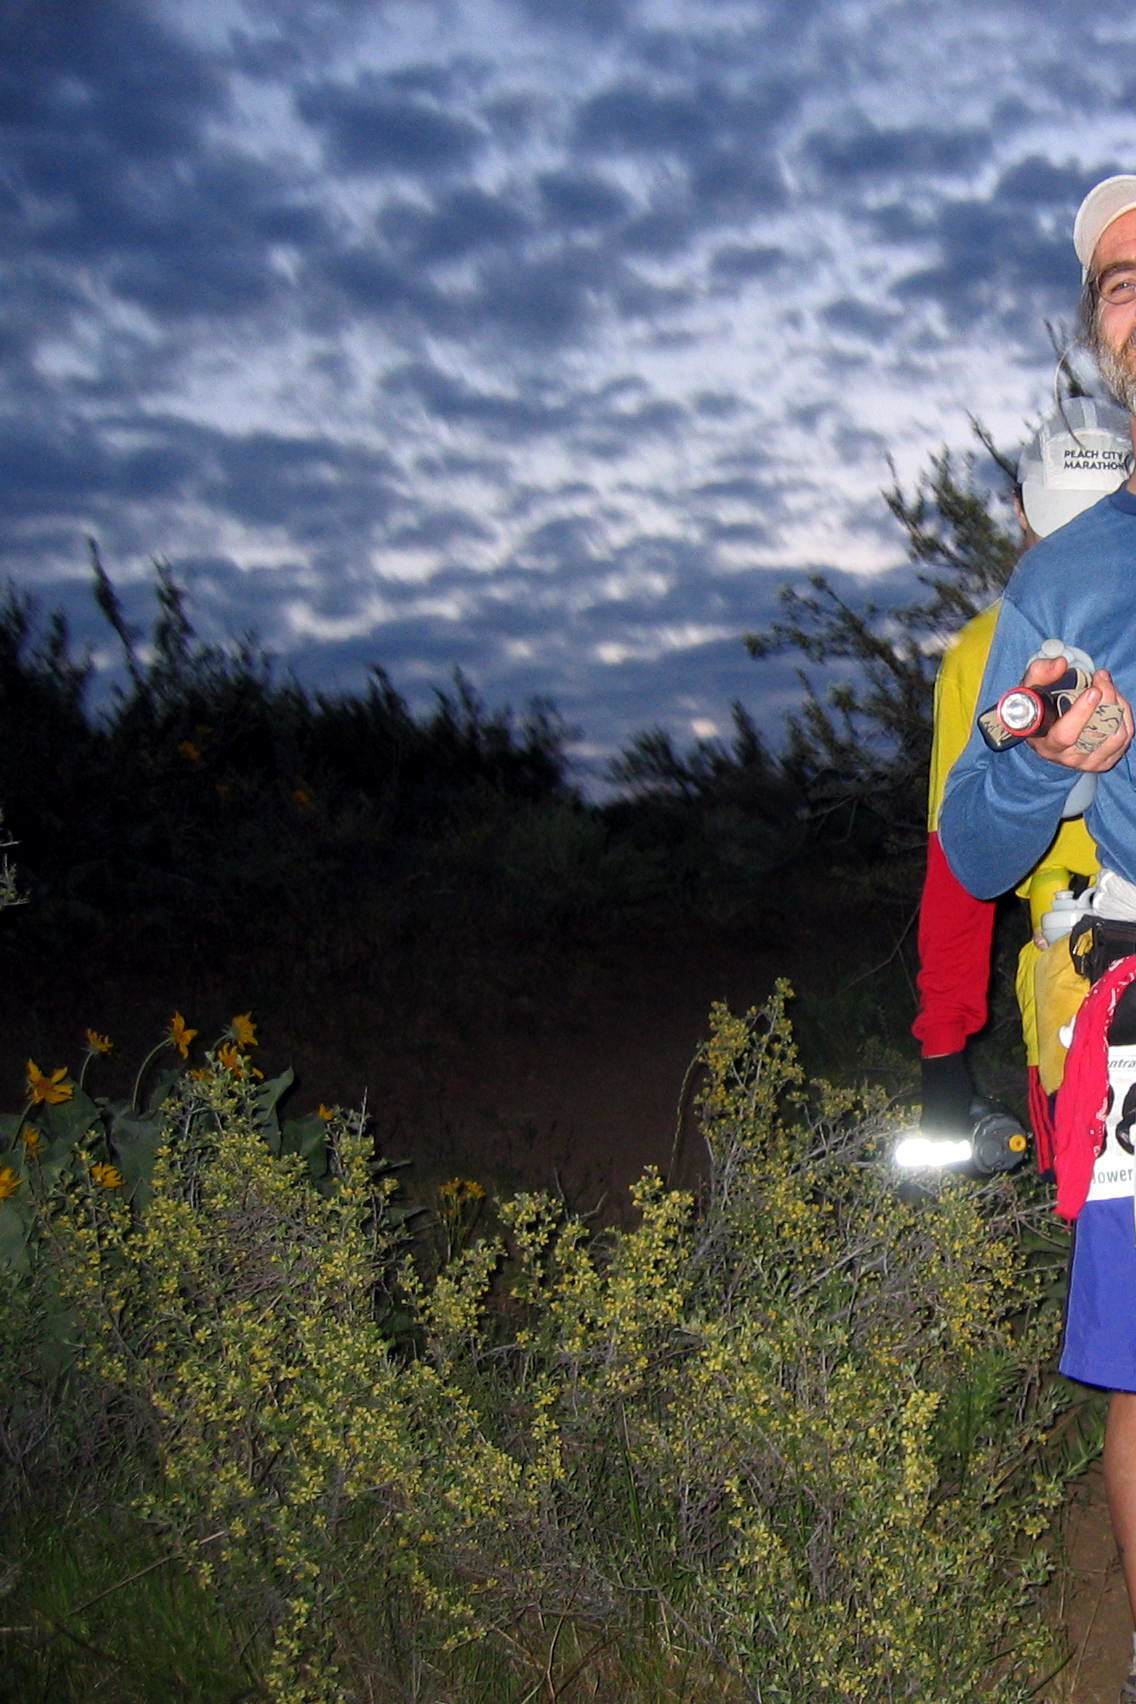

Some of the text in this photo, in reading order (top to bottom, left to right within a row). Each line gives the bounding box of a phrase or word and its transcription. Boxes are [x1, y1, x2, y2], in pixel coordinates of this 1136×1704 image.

[1064, 450, 1123, 460] PEACH CITY
[1064, 460, 1125, 470] MARATHON
